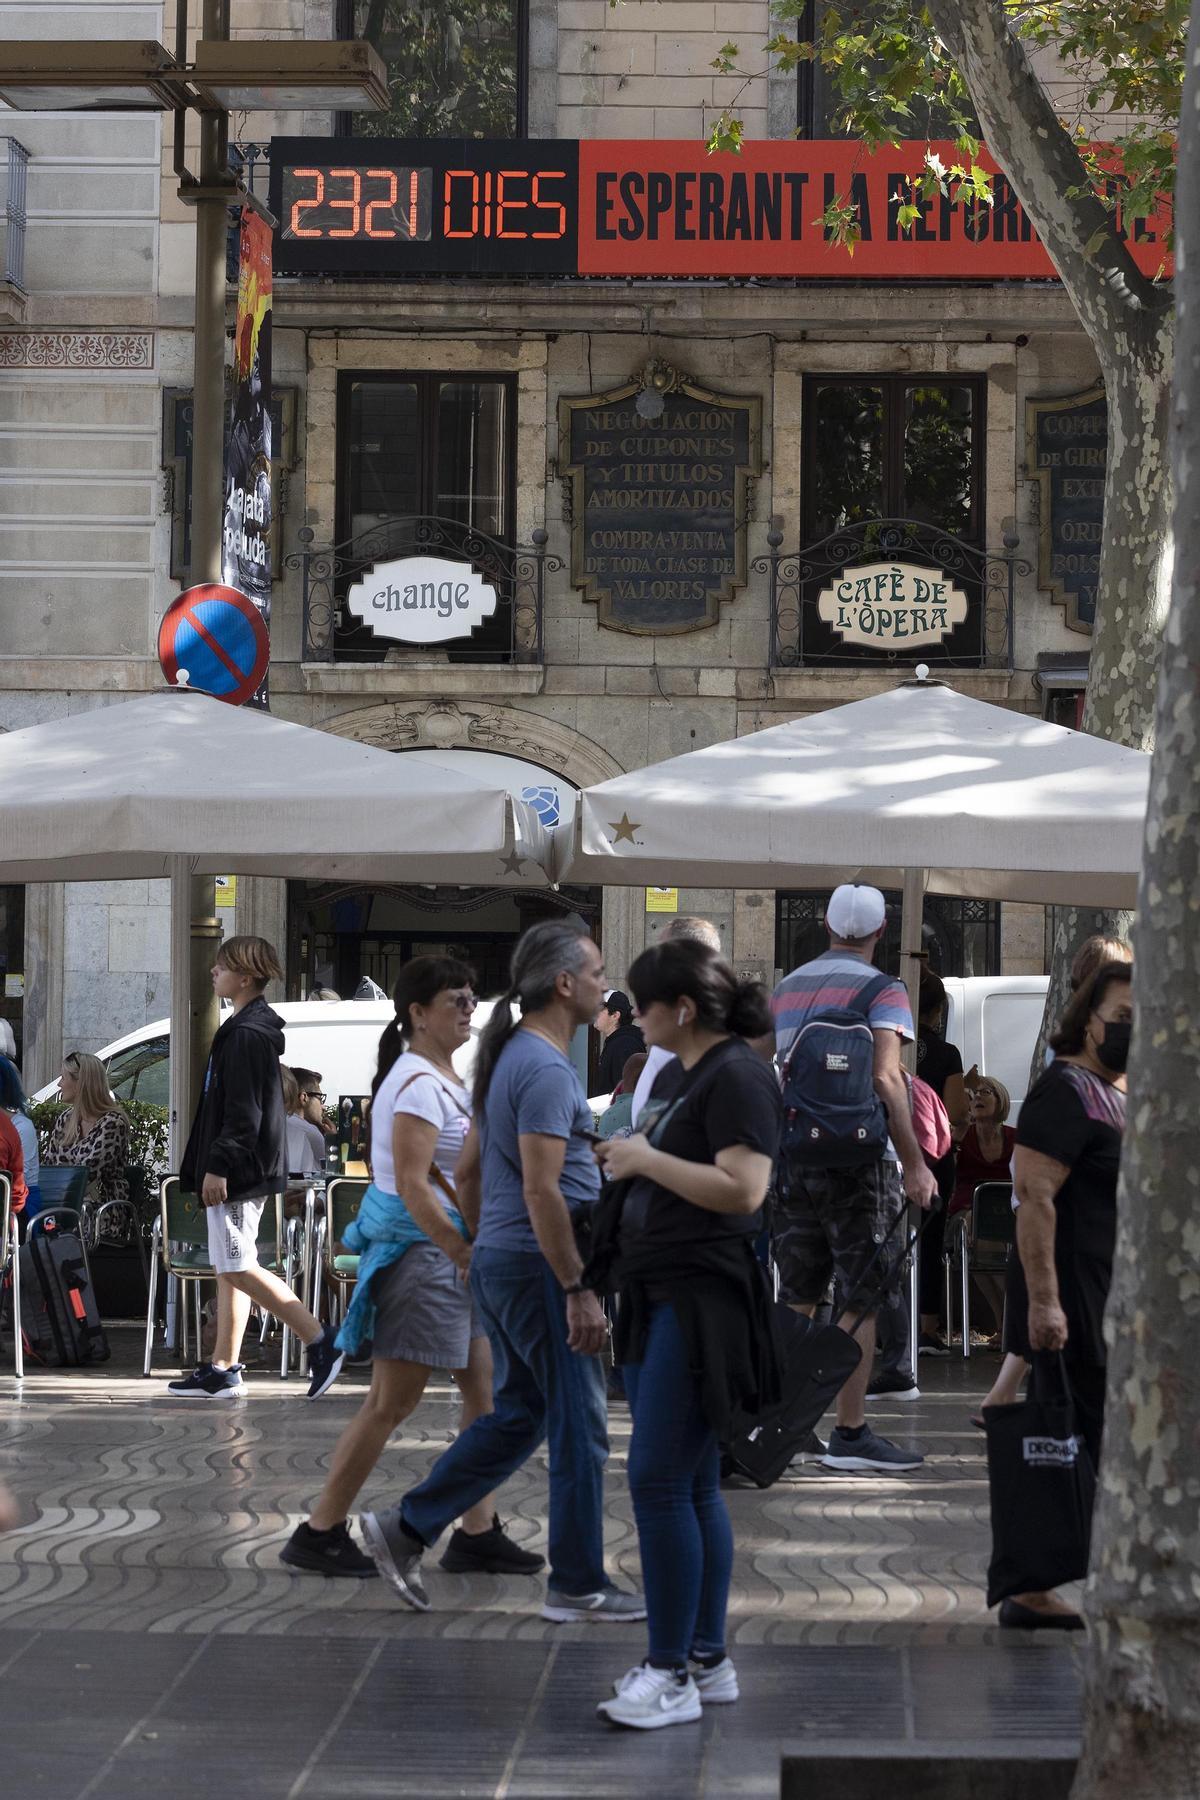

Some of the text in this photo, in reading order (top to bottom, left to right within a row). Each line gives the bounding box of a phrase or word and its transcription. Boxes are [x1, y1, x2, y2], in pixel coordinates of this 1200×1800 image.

[291, 169, 567, 239] 2321 DIES
[596, 171, 809, 241] ESPERANT
[824, 172, 873, 242] LA
[887, 173, 1042, 242] REFOR
[584, 437, 735, 457] DE CUPONES
[1039, 452, 1062, 466] DE
[599, 463, 724, 483] Y TITULOS
[587, 489, 735, 509] AMORTIZADOS
[590, 531, 727, 551] COMPRA-VENTA
[585, 557, 735, 574] DE TODA CLASE DE
[372, 582, 470, 618] change
[614, 580, 706, 600] VALORES
[913, 577, 948, 604] DE
[810, 1127, 867, 1139] S D
